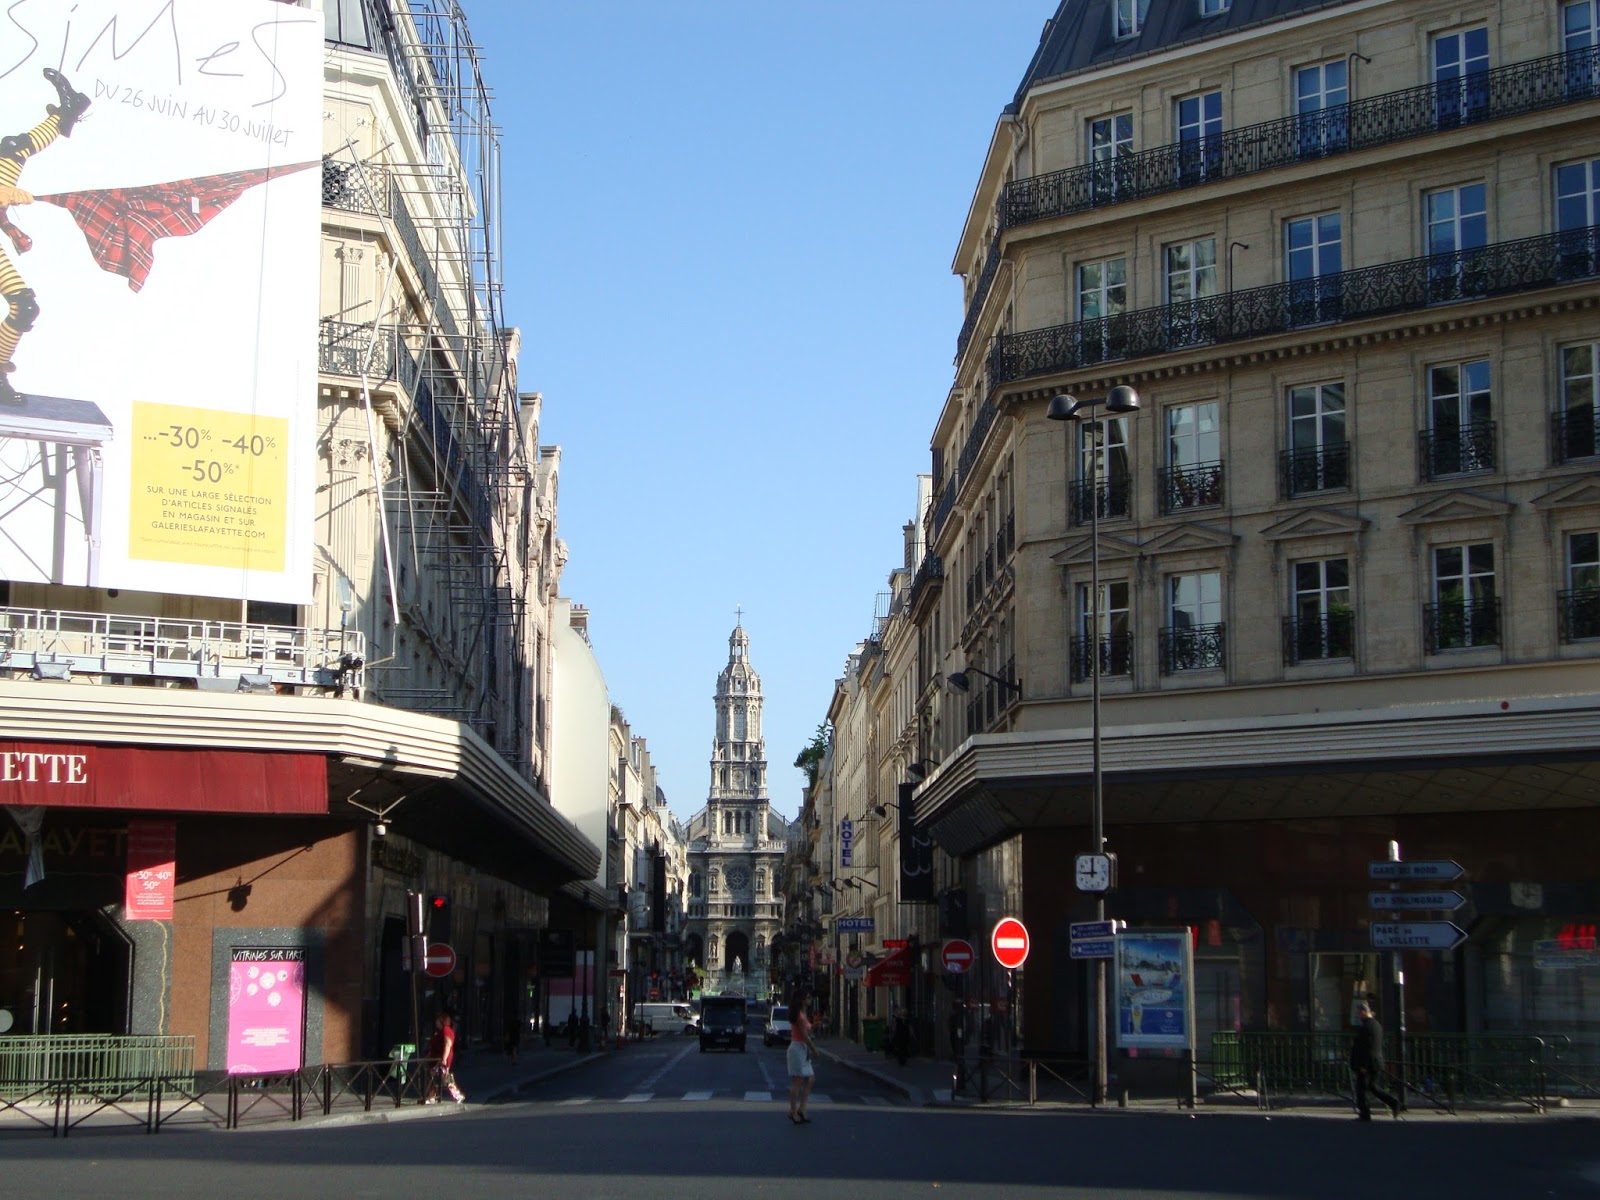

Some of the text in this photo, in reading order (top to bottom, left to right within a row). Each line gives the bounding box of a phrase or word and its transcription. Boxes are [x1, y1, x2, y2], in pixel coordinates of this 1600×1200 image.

[95, 79, 119, 99] DU
[121, 88, 143, 107] 26
[192, 106, 216, 125] AU
[218, 111, 240, 132] 30
[147, 485, 164, 494] SUR
[168, 488, 188, 497] UNE
[191, 490, 220, 500] LARGE
[161, 498, 212, 511] D'ARTICLES
[162, 510, 255, 526] EN MAGASIN ET SUR
[151, 521, 266, 539] GALERIESLAFAYETTE.COM
[841, 821, 852, 867] HOTEL
[1376, 926, 1399, 934] PARC
